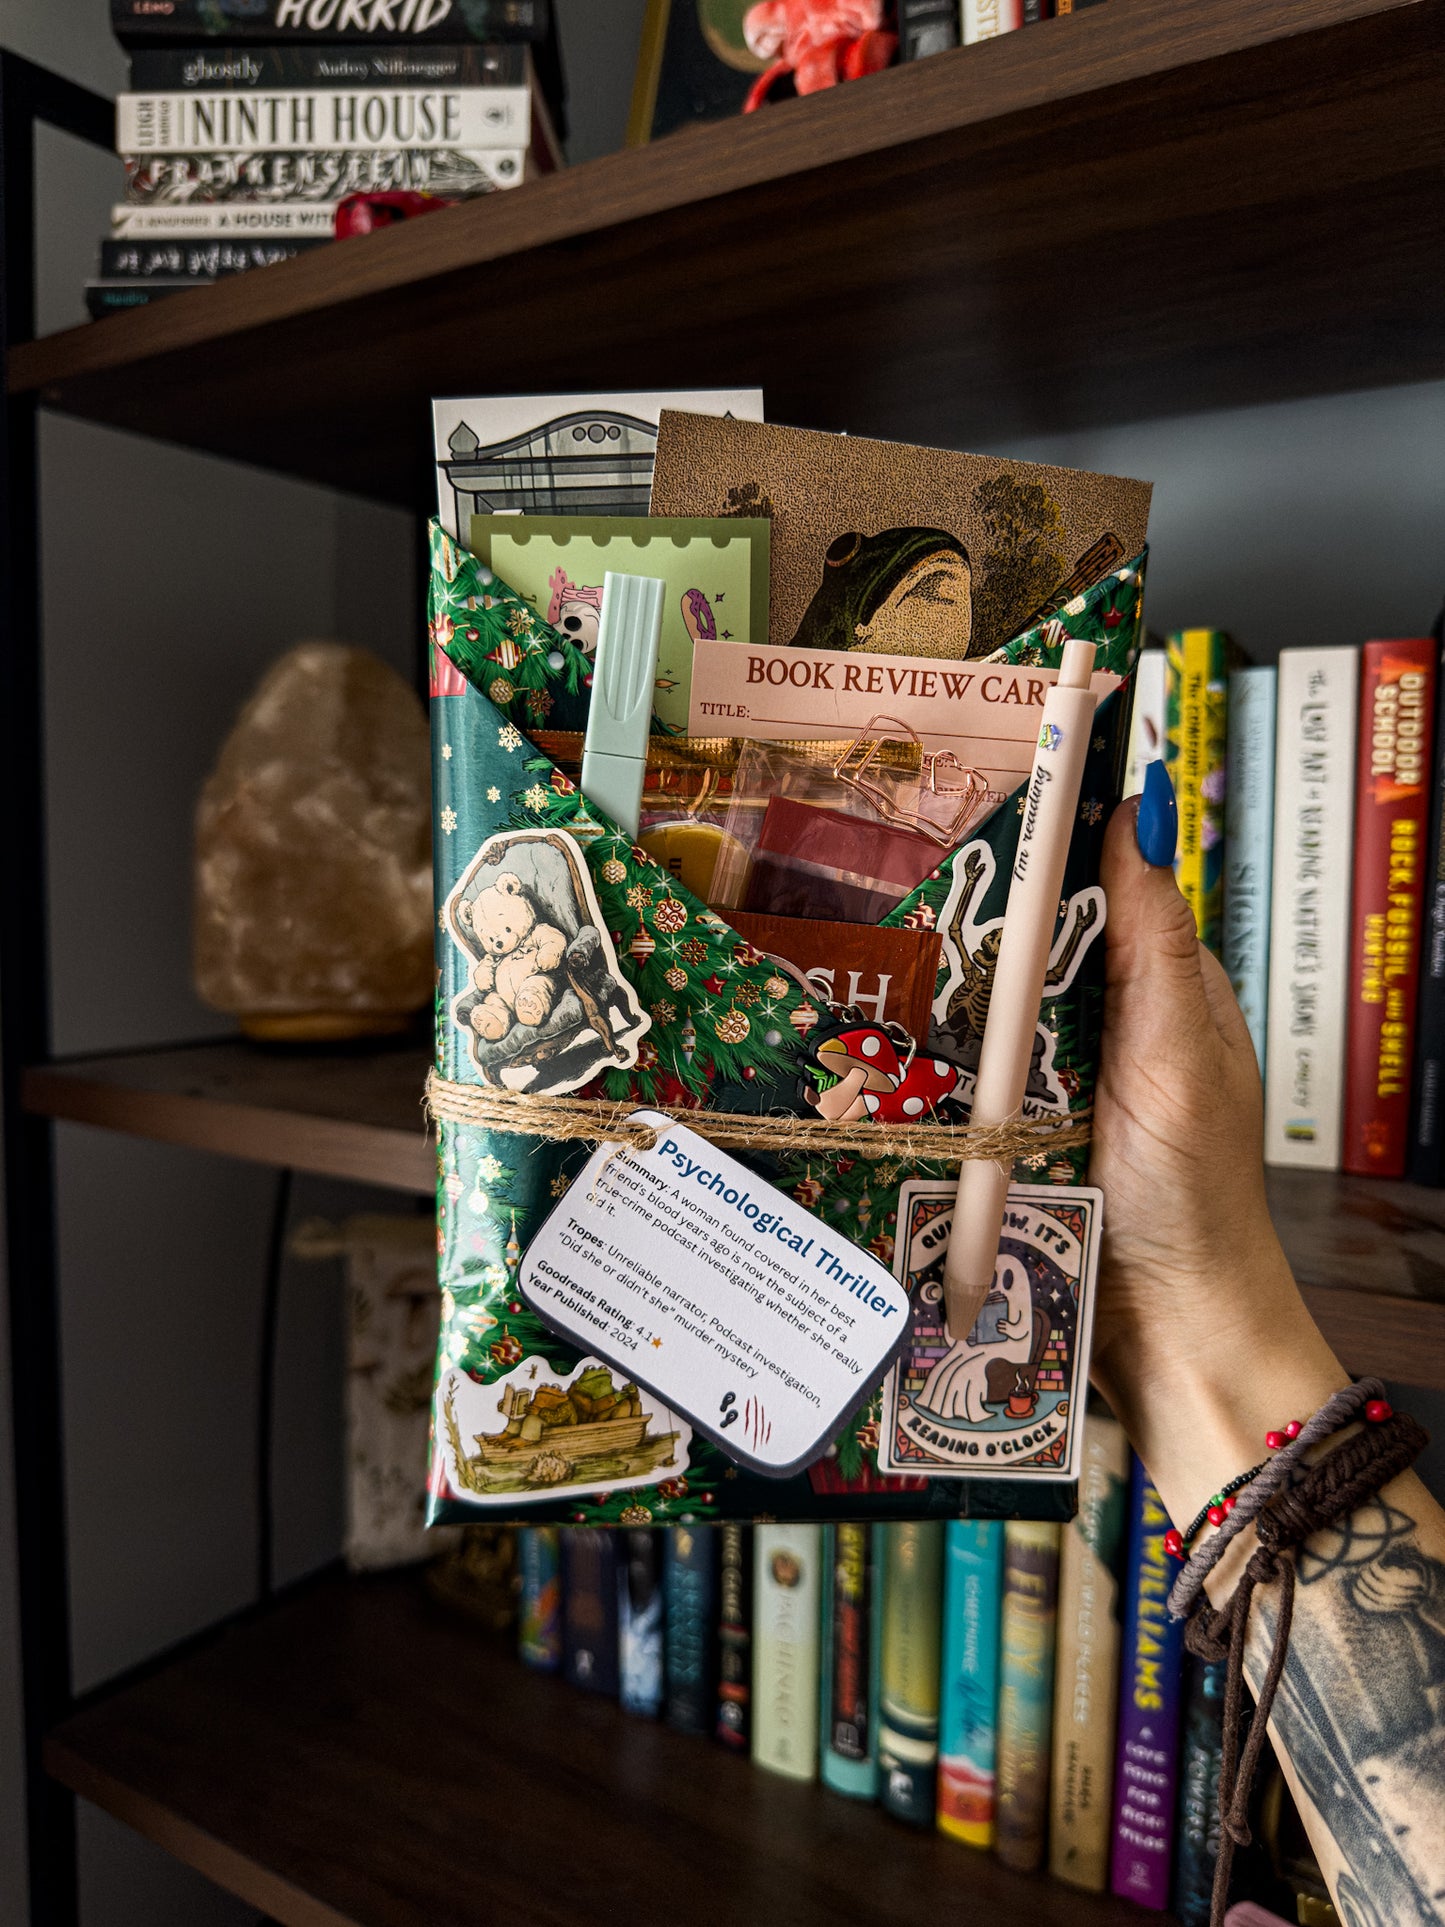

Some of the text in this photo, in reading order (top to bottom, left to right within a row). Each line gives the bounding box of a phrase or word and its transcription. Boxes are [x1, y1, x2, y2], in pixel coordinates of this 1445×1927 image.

[183, 55, 264, 85] ghostly
[191, 93, 462, 146] NINTH HOUSE
[149, 154, 432, 186] FRANKENSTEIN
[236, 212, 291, 228] HOUSE
[700, 702, 751, 719] TITLE:
[747, 656, 1058, 706] BOOK REVIEW CAR
[1371, 683, 1397, 777] SCHOOL
[1396, 672, 1424, 785] OUTDOOR
[1023, 765, 1053, 842] reading
[1388, 818, 1417, 890] ROCK,
[1230, 862, 1259, 975] SIGNS
[1385, 892, 1415, 988] FOSSIL,
[1376, 1020, 1408, 1099] SHELL
[605, 1202, 616, 1217] it.
[614, 1148, 856, 1328] Summary: A woman found covered in her best
[657, 1138, 898, 1318] Psychological Thriller
[537, 1259, 653, 1342] Goodreads Rating: 4.1
[595, 1177, 863, 1375] true-crime podcast investigating whether she really
[646, 1191, 681, 1220] blood
[676, 1216, 706, 1239] years
[702, 1232, 730, 1256] ago
[730, 1250, 742, 1264] is
[740, 1260, 766, 1281] now
[765, 1277, 786, 1296] the
[784, 1292, 827, 1327] subject
[826, 1323, 842, 1335] of
[838, 1333, 848, 1343] a
[528, 1271, 638, 1351] Year Published: 2024
[567, 1217, 820, 1408] Tropes: Unreliable narrator, Podcast investigation,
[581, 1249, 602, 1267] she
[602, 1264, 617, 1276] or
[673, 1313, 715, 1344] murder
[714, 1342, 759, 1378] mystery
[906, 1416, 979, 1457] READING
[1134, 1472, 1169, 1711] IA WILLIAMS
